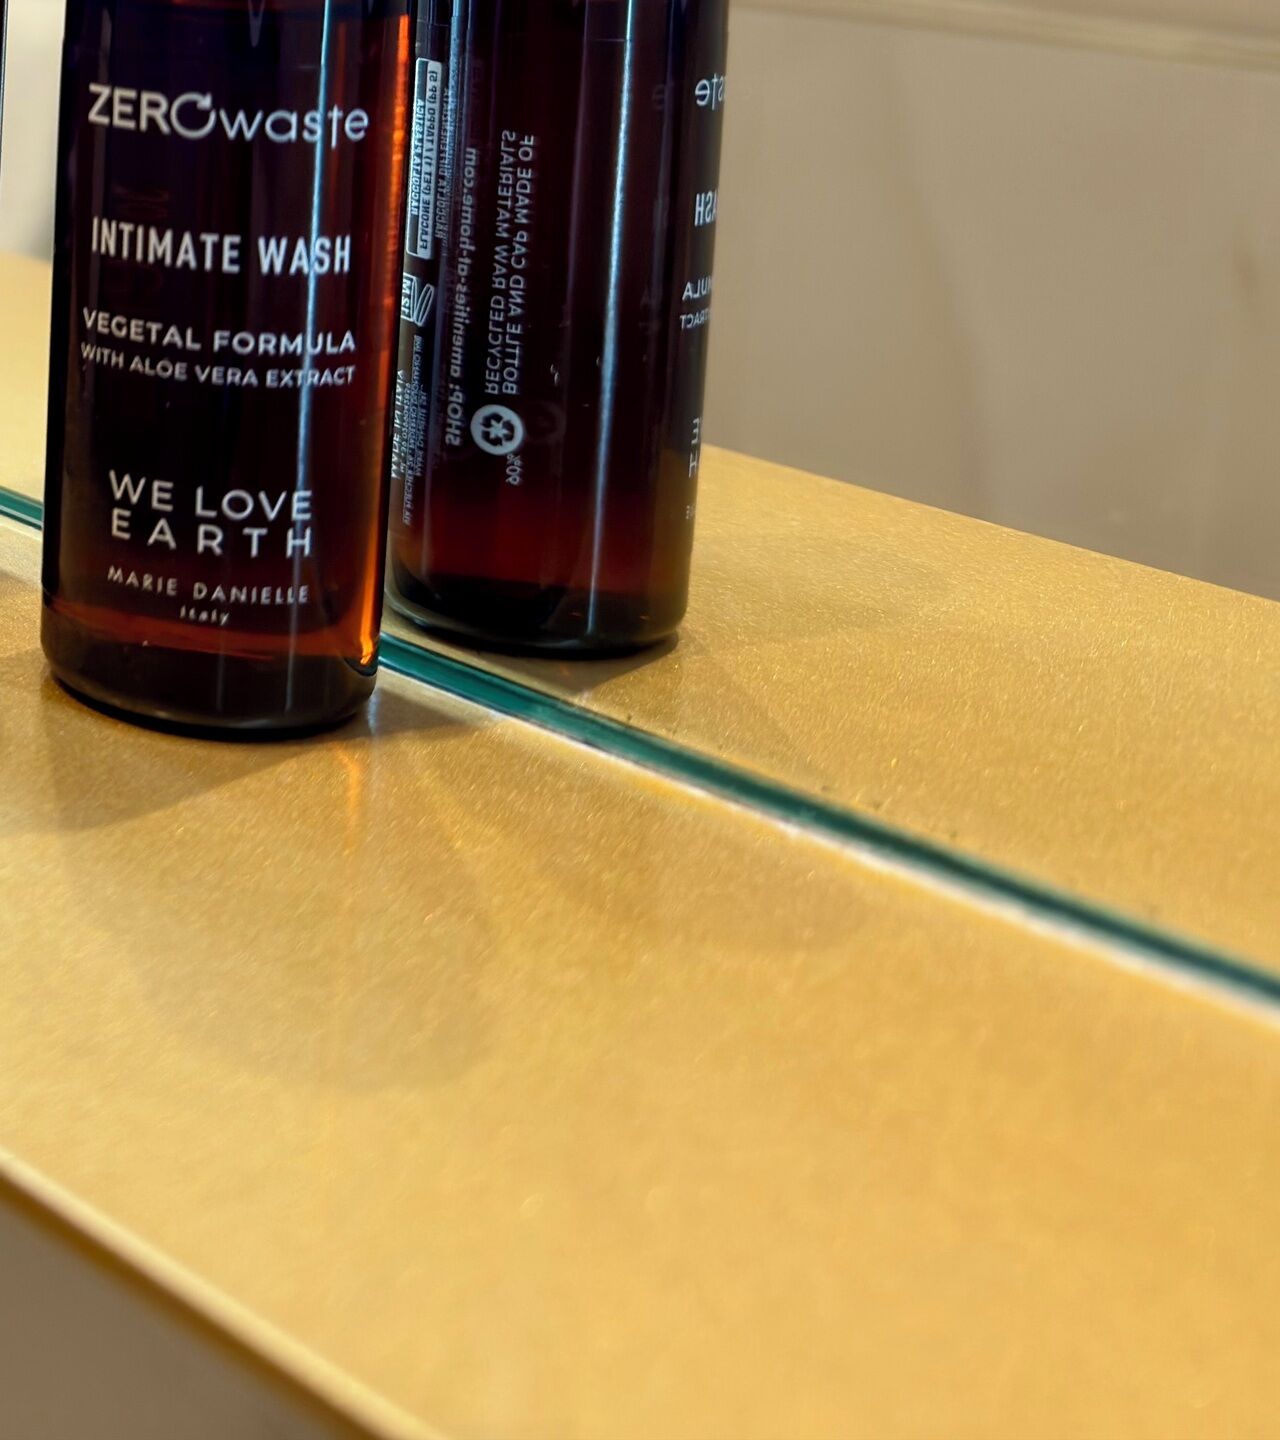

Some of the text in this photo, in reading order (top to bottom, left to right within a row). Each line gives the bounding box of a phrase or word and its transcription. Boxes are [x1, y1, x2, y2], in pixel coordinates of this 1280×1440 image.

[92, 216, 351, 275] INTIMATE WASH
[83, 308, 355, 356] VEGETAL FORMULA
[81, 341, 354, 388] WITH ALOE VERA EXTRACT
[109, 469, 312, 522] WE LOVE
[112, 508, 312, 558] EARTH
[108, 565, 308, 604] MARIE DANIELLE
[180, 605, 228, 626] Italy
